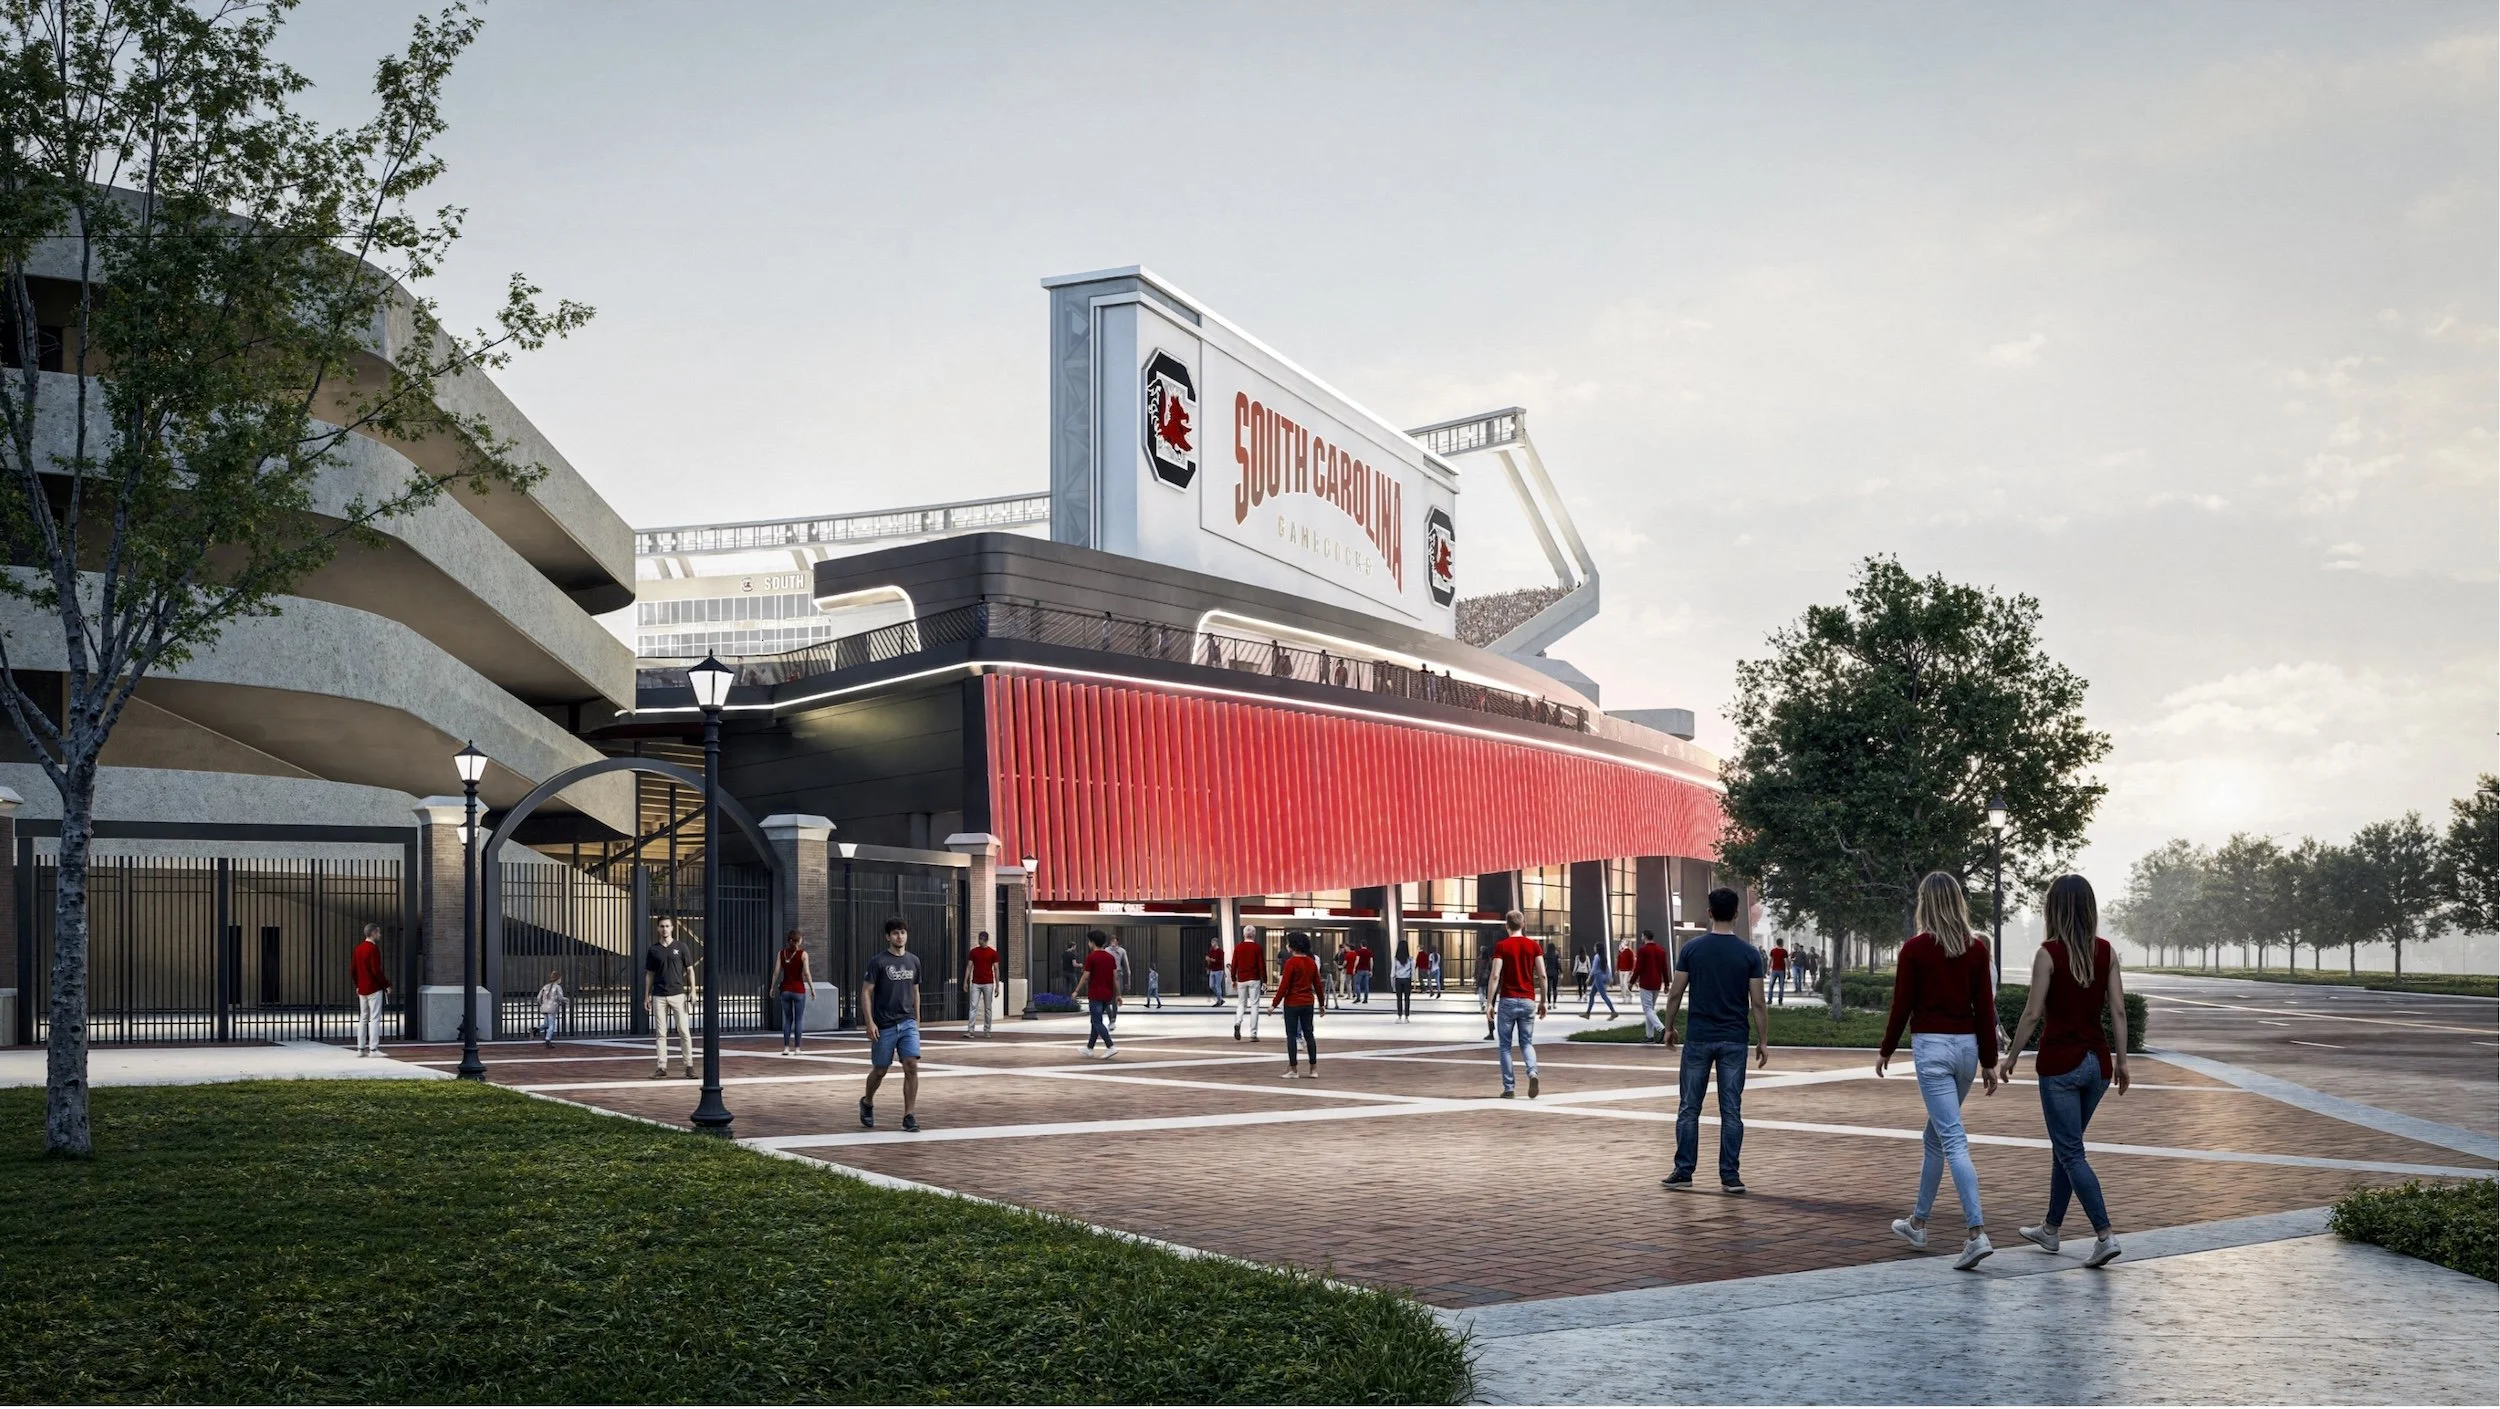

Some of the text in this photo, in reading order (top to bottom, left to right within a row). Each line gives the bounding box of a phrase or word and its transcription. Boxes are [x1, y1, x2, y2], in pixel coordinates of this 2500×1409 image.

[1234, 390, 1403, 595] SOUTH CAROLINA
[1278, 515, 1372, 576] GAMECOCKS
[764, 574, 805, 591] SOUTH
